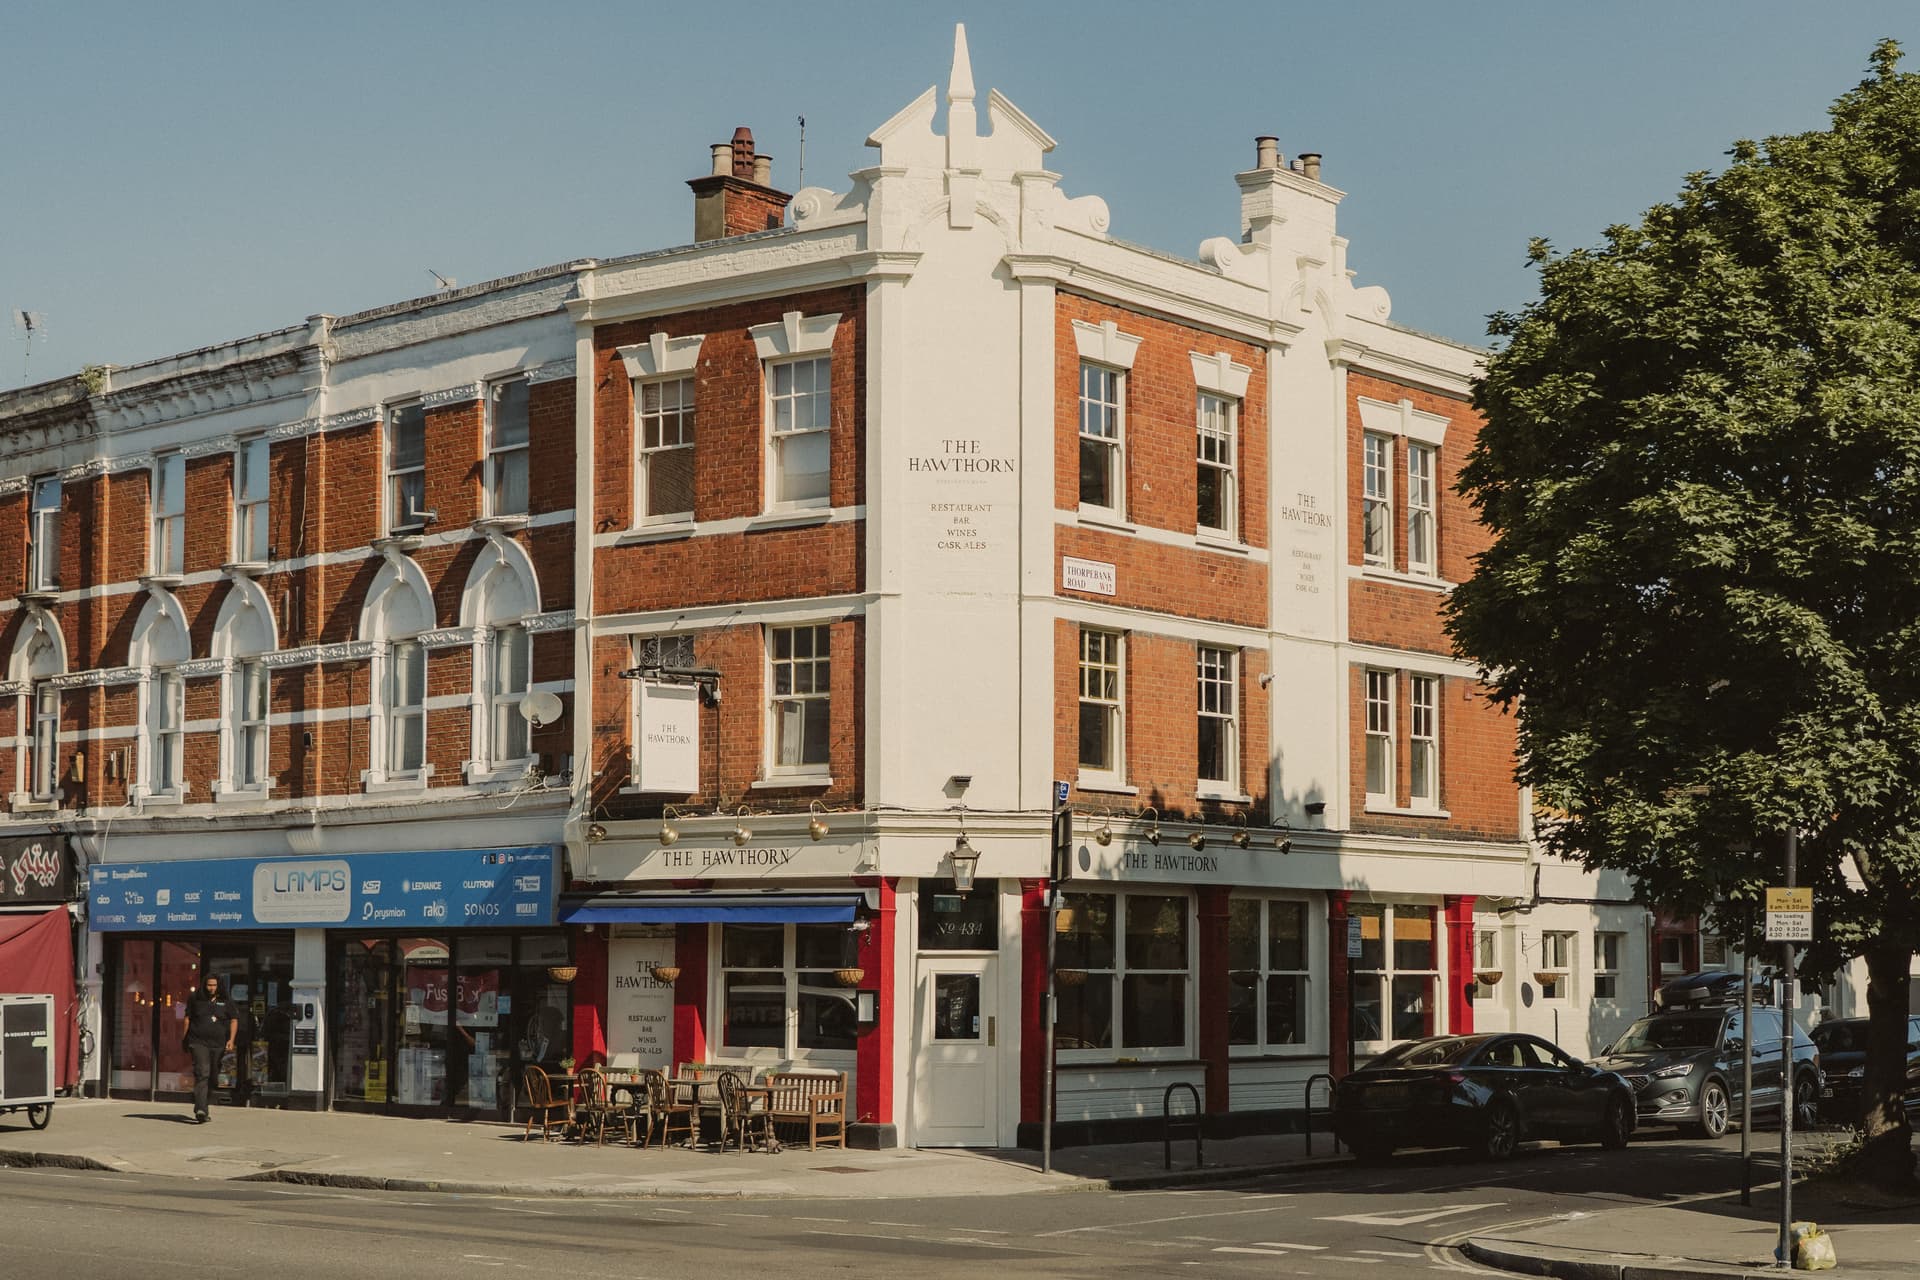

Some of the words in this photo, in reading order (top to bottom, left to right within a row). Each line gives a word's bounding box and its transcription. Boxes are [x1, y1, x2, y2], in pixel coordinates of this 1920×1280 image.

[942, 439, 981, 454] THE
[908, 457, 1015, 473] HAWTHORN
[1297, 493, 1316, 508] THE
[930, 503, 992, 512] RESTAURANT
[953, 516, 970, 525] BAR
[1281, 506, 1332, 528] HAWTHORN
[946, 529, 977, 537] WINES
[937, 541, 961, 550] CASK
[964, 541, 987, 550] ALES
[1067, 565, 1112, 582] THORPEBANK
[1067, 577, 1086, 589] ROAD
[1099, 582, 1112, 593] W12
[661, 723, 678, 734] THE
[647, 734, 691, 745] HAWTHORN
[663, 851, 693, 867] THE
[702, 848, 790, 866] HAWTHORN
[1123, 852, 1148, 869] THE
[1154, 854, 1218, 872] HAWTHORN
[274, 868, 346, 893] LAMPS
[411, 881, 442, 891] LEDVANCE
[423, 901, 445, 917] rako
[464, 903, 500, 916] SONOS
[167, 912, 196, 922] Hamilton
[959, 920, 984, 936] 434
[616, 976, 674, 989] HAWTHOR
[426, 984, 448, 1002] Fus
[628, 1015, 667, 1023] RESTAURANT
[638, 1036, 657, 1044] WINES
[631, 1047, 647, 1055] CASK
[648, 1047, 663, 1055] ALES
